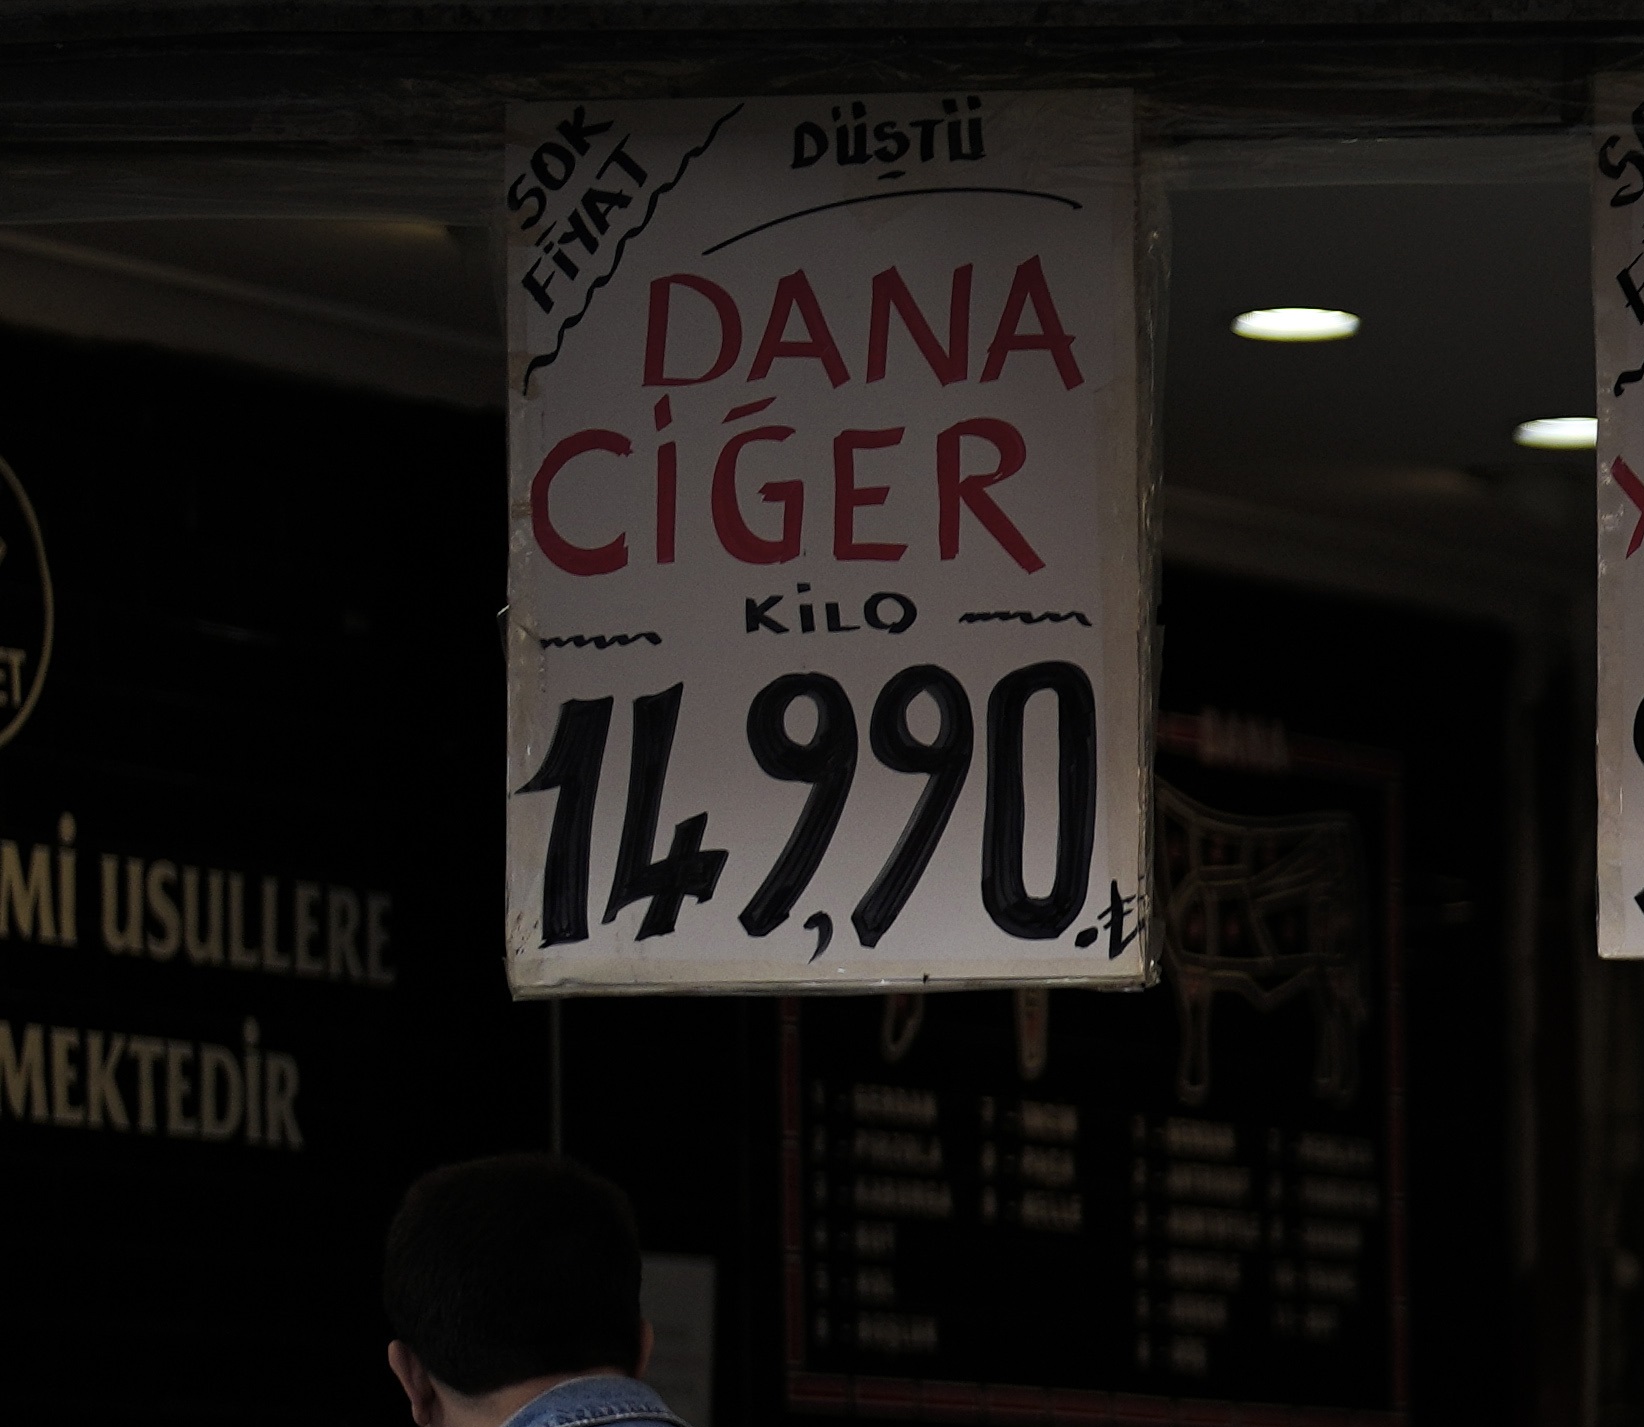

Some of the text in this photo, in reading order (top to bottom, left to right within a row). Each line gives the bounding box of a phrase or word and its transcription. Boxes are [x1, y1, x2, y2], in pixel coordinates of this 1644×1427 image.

[792, 98, 986, 180] DÜŞTÜ
[521, 134, 648, 314] FİYAT
[642, 255, 1086, 391] DANA
[530, 395, 1047, 576] CİĞER
[745, 583, 918, 636] KİLO
[99, 850, 396, 990] USULLERE
[0, 1015, 305, 1153] MEKTEDİR
